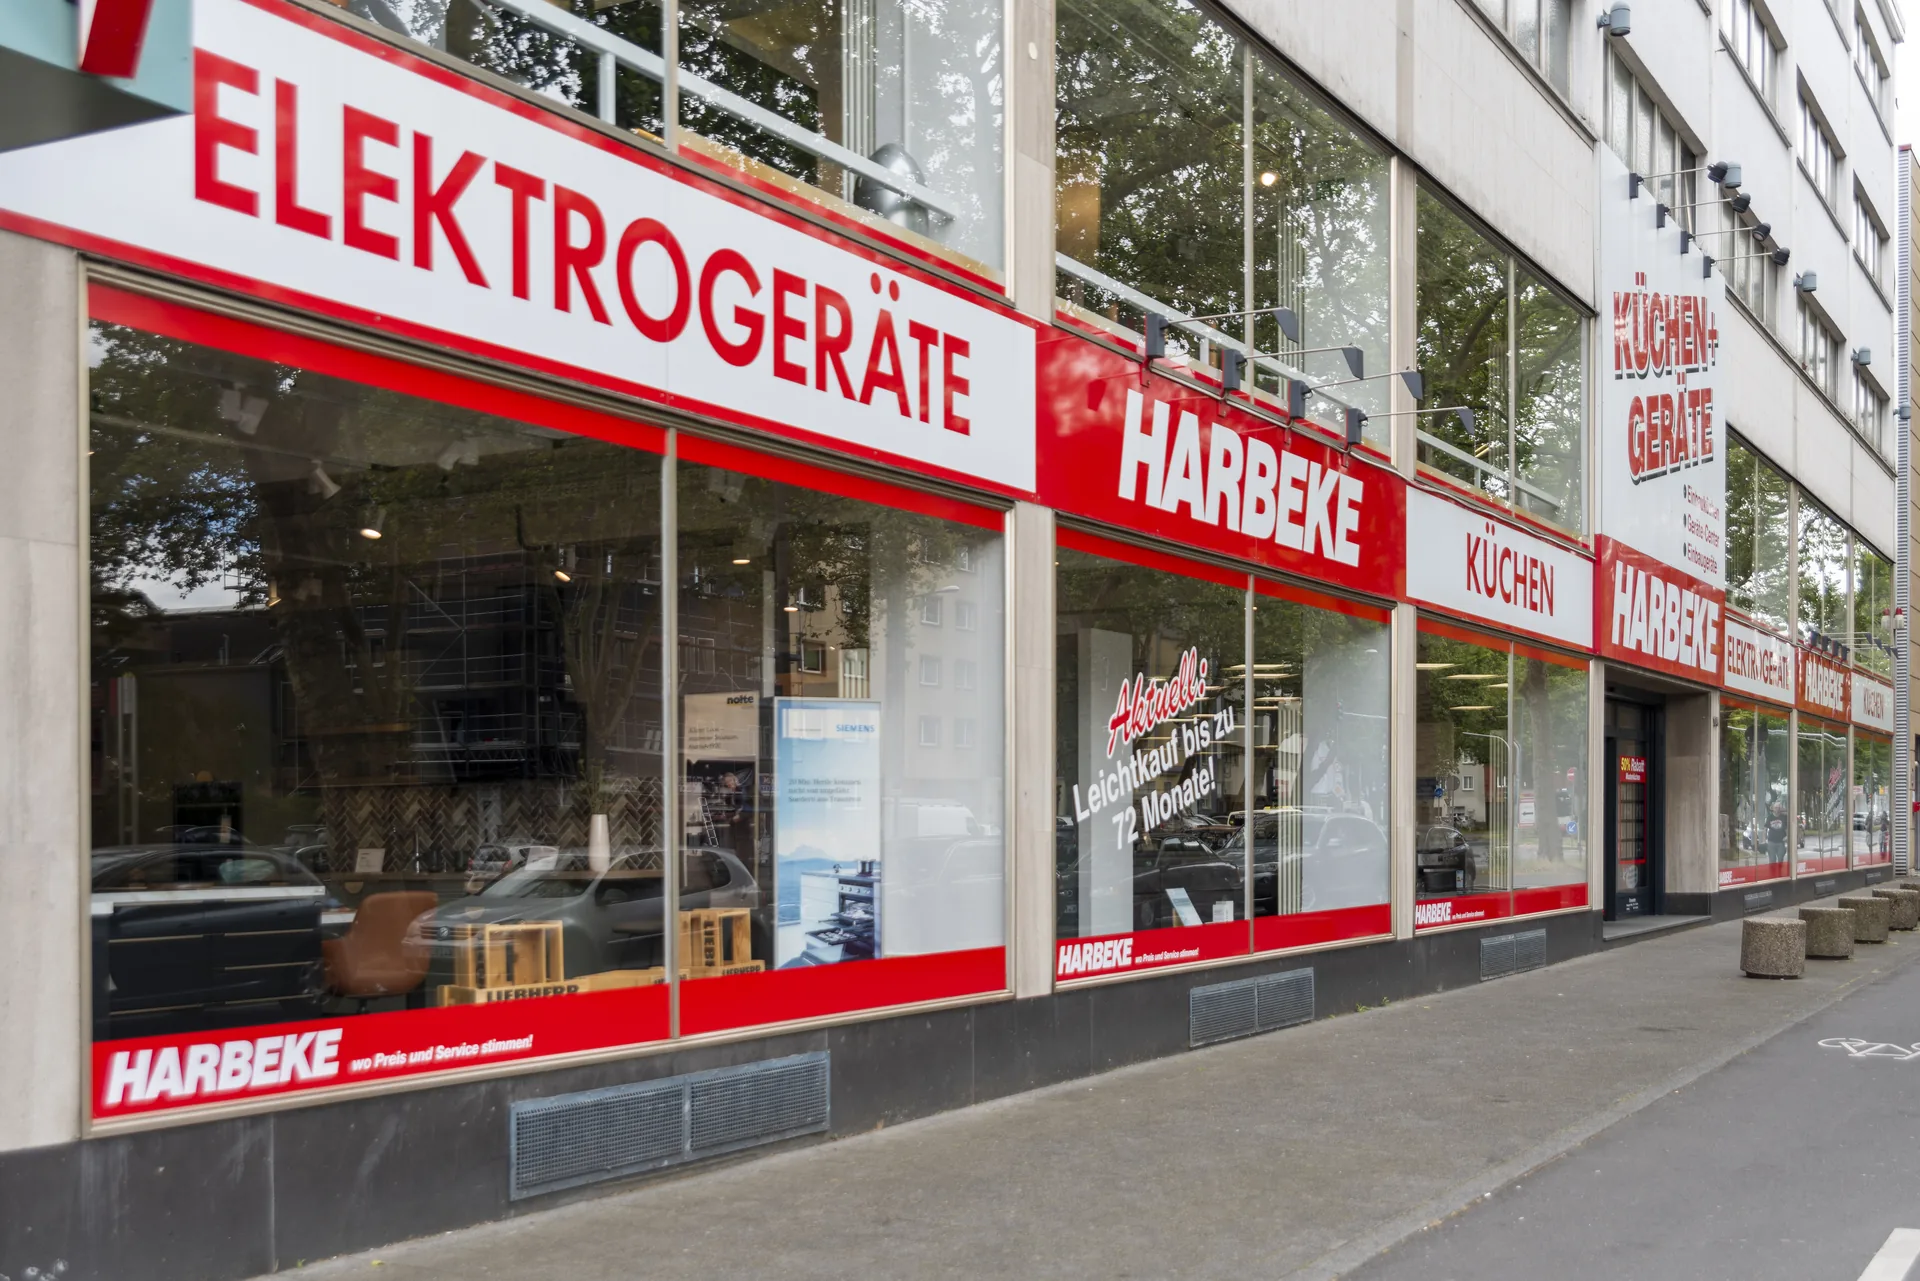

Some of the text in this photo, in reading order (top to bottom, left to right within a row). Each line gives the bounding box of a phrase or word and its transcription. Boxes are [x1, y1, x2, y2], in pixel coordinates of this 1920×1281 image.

[194, 47, 971, 437] ELEKTROGERÄTE
[1627, 371, 1714, 485] GERÄTE
[1118, 388, 1364, 568] HARBEKE
[1466, 521, 1554, 617] KÜCHEN
[1611, 559, 1720, 674] HARBEKE
[726, 694, 754, 705] nolte
[836, 724, 876, 733] SIEMENS
[1106, 646, 1208, 759] Aktuell:
[1804, 659, 1844, 712] HARBEKE
[1072, 705, 1236, 824] Leichtkauf bis zu
[1112, 756, 1217, 850] 72 Monate!
[1631, 758, 1645, 772] Rabatt
[1057, 938, 1133, 975] HARBEKE
[1415, 901, 1452, 924] HARBEKE
[104, 1028, 534, 1107] HARBEKE wo Preis und Service stimmen!
